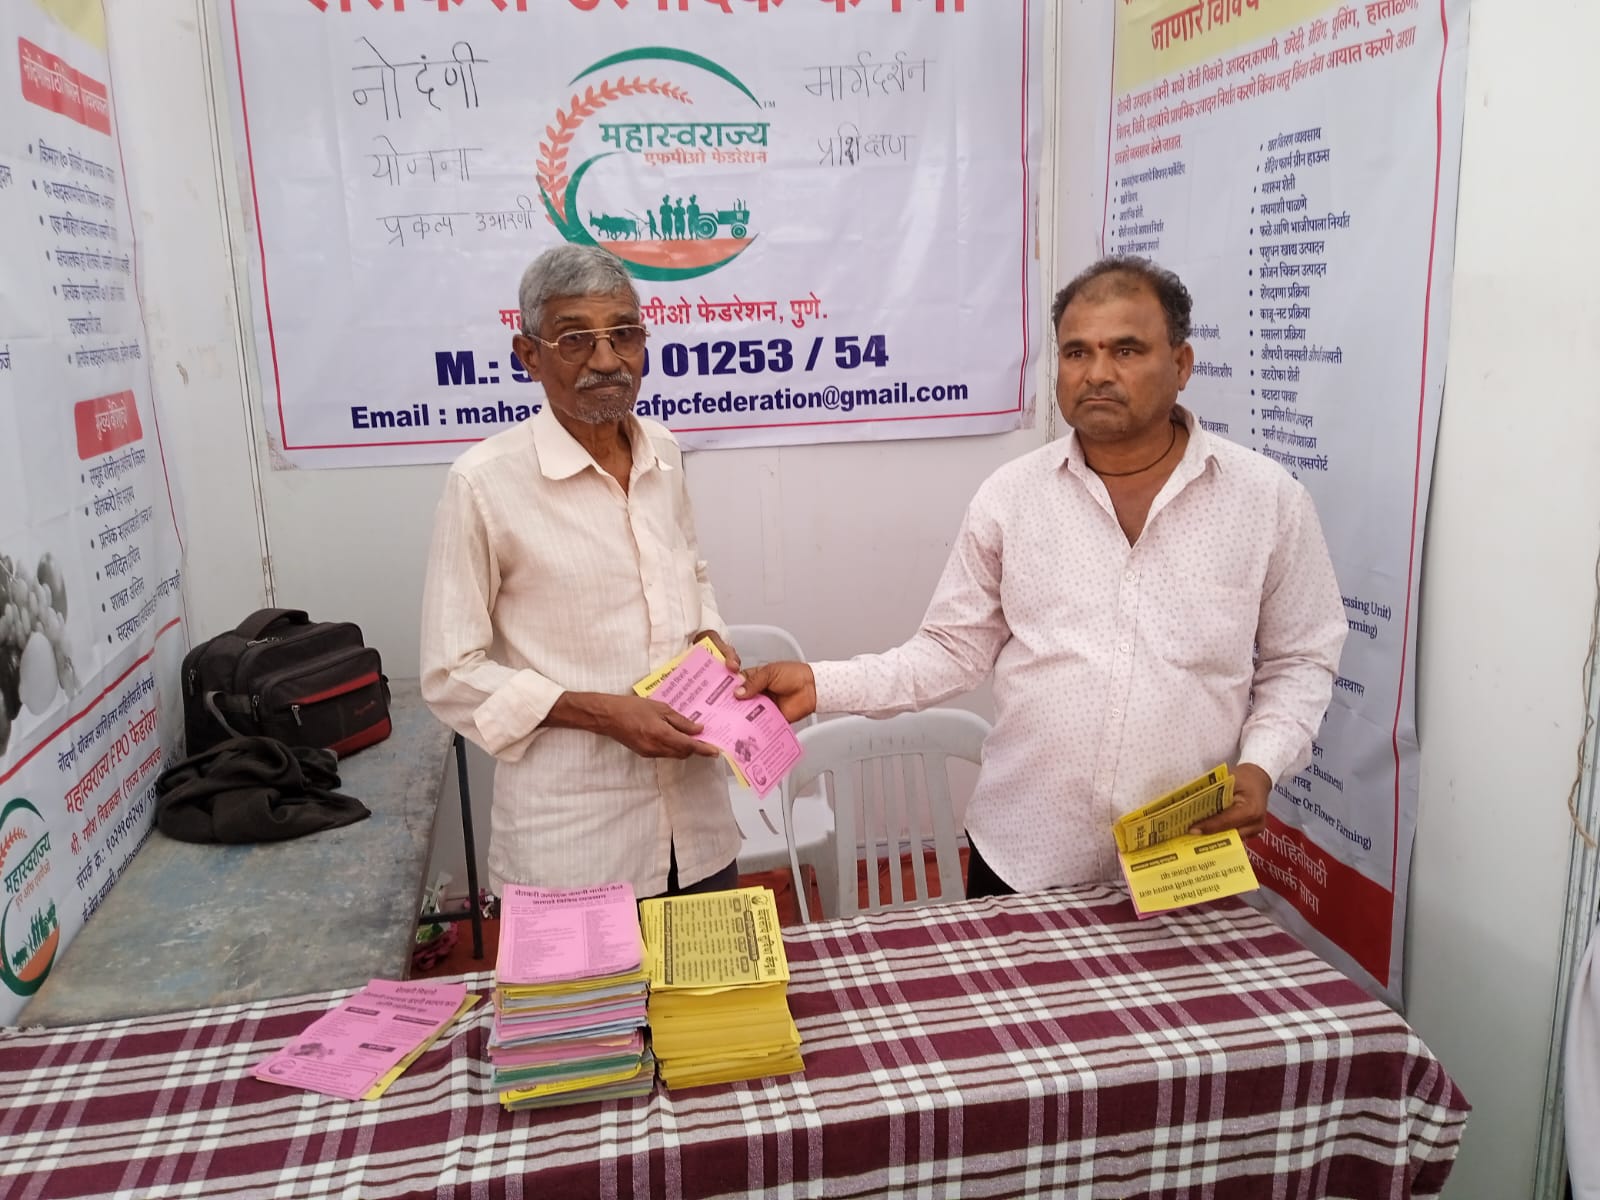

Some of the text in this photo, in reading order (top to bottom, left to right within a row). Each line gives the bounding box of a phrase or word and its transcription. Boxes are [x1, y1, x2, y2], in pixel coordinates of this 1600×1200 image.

[1326, 43, 1362, 69] आयात
[1365, 28, 1394, 60] करणे
[598, 121, 770, 152] महास्वराज्य
[368, 135, 483, 187] योजना
[644, 147, 767, 168] एफपीओ फेडरेशन
[698, 295, 784, 325] फेडरेशन,
[790, 291, 828, 328] पुणे.
[1260, 329, 1283, 341] मसाला
[661, 338, 793, 378] 01253
[804, 336, 825, 372] /
[835, 334, 889, 370] 54
[351, 403, 430, 429] Email
[1370, 602, 1392, 621] Unit)
[64, 765, 111, 816] महास्वराज्य
[1302, 798, 1313, 812] Or
[1314, 804, 1336, 827] Flower
[1336, 819, 1373, 851] Farming)
[4, 831, 51, 894] महास्वराज्य
